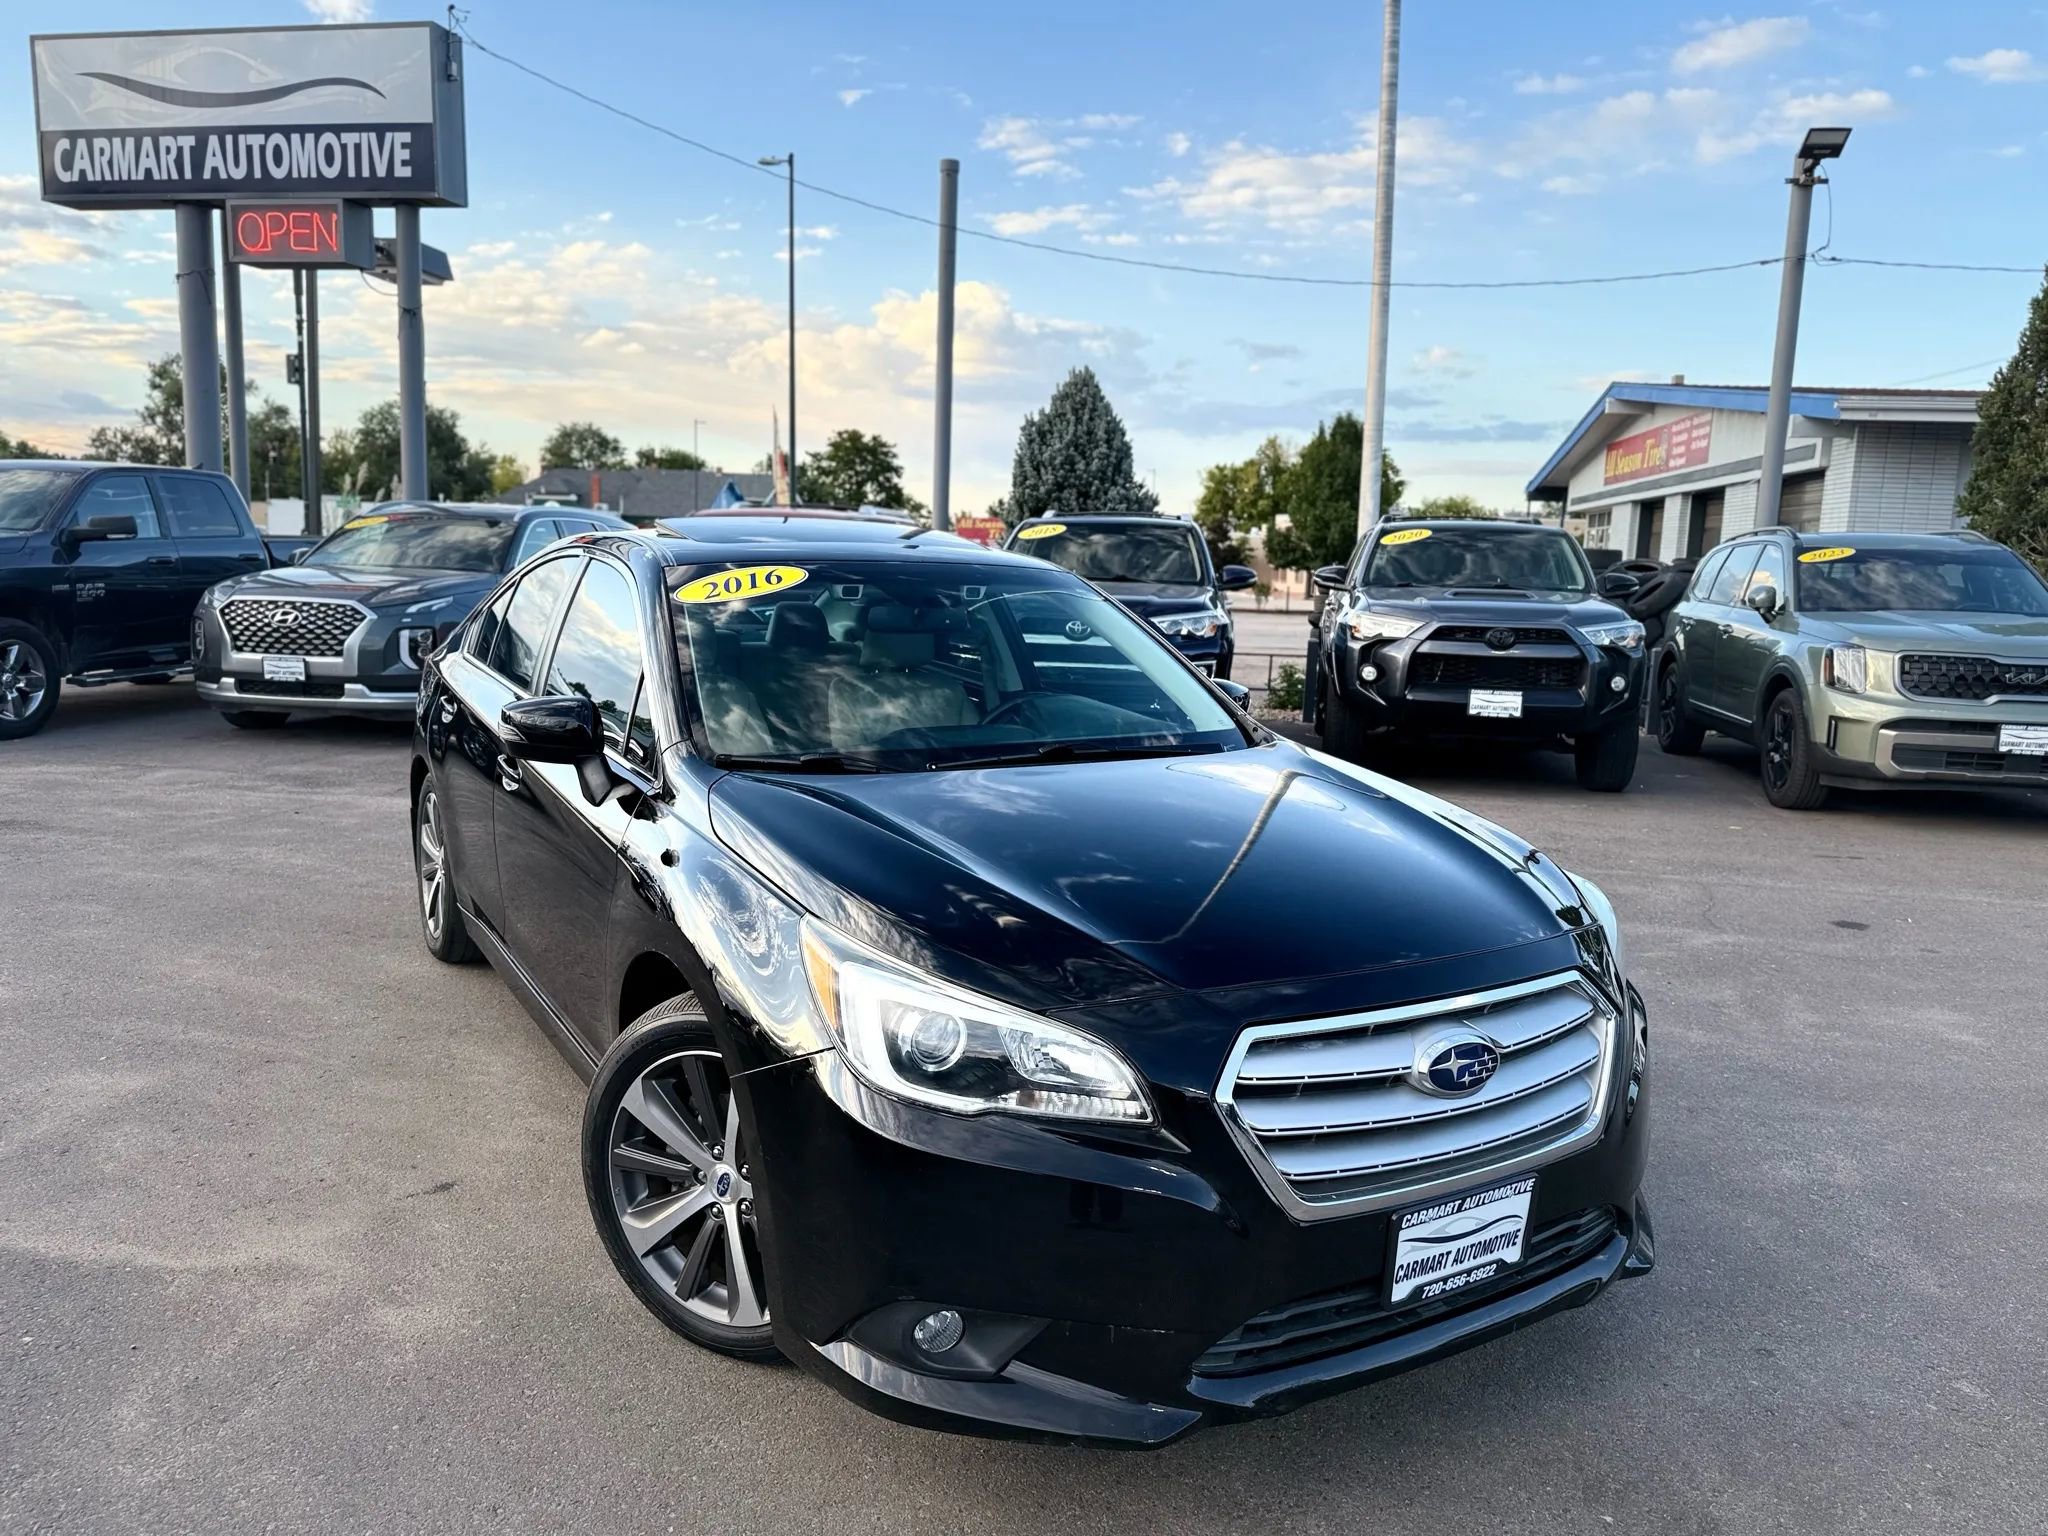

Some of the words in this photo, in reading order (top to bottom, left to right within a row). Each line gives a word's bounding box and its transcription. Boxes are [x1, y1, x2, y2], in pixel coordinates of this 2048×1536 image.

[53, 135, 196, 183] CARMART
[202, 131, 413, 180] AUTOMOTIVE
[237, 211, 339, 253] OPEN
[1616, 448, 1642, 476] Season
[702, 568, 783, 600] 2016
[1401, 1199, 1463, 1229] CARMART
[1461, 1177, 1536, 1211] AUTOMOTIVE
[1394, 1249, 1453, 1286] CARMART
[1450, 1227, 1522, 1268] AUTOMOTIVE
[1421, 1263, 1497, 1300] 720-656-6922
